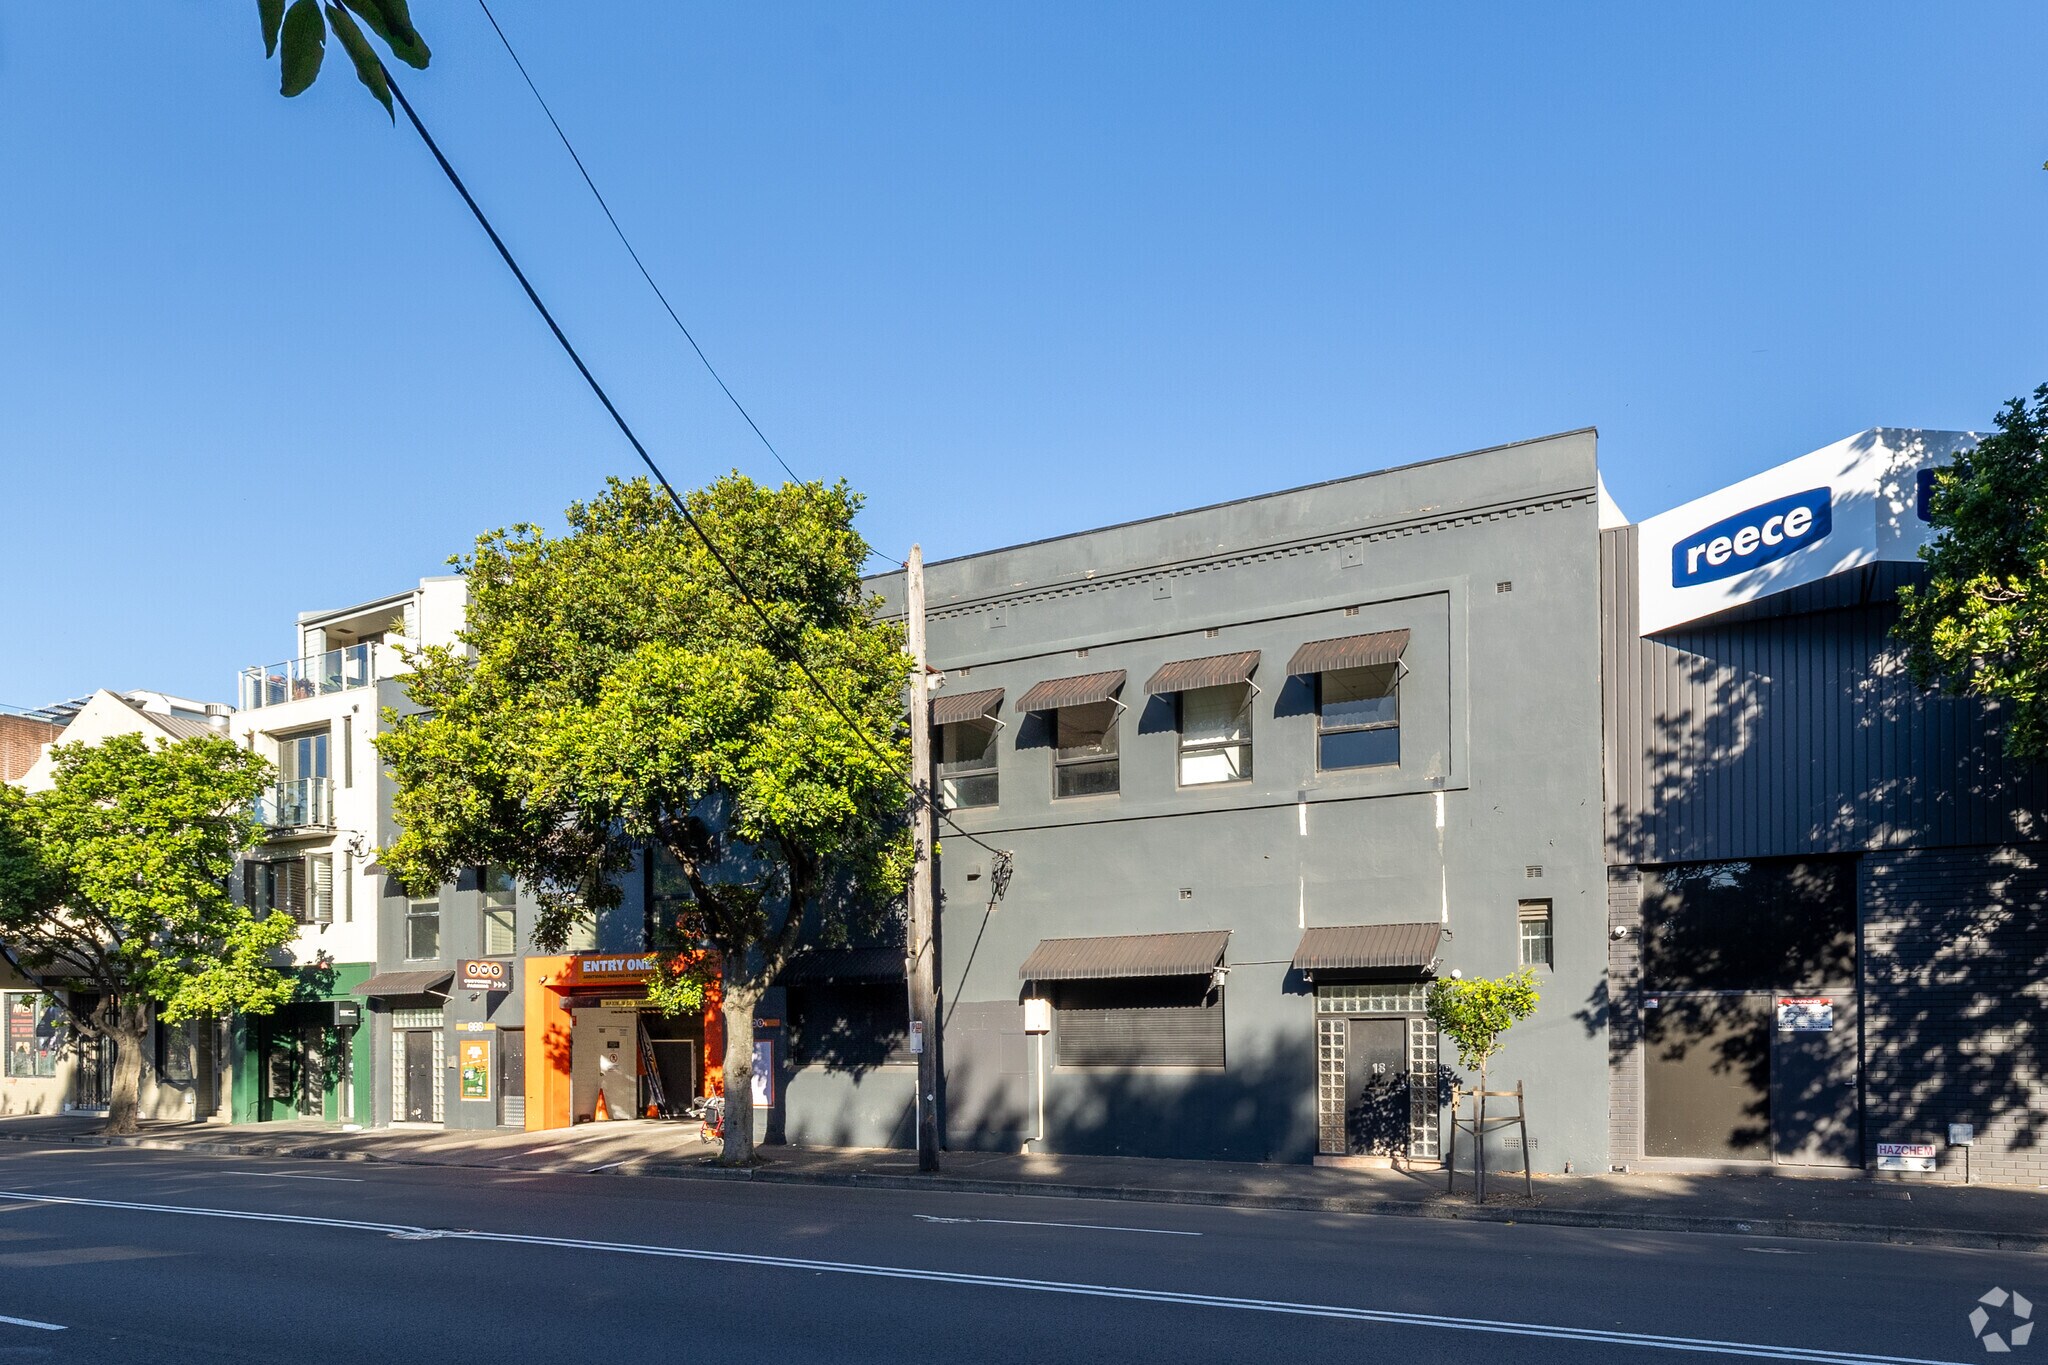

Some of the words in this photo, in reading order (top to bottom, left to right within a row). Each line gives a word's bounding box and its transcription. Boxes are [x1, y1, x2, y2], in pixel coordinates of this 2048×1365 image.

[1687, 507, 1813, 575] reece
[467, 963, 501, 977] BWS
[583, 960, 624, 972] ENTRY
[1372, 1062, 1386, 1074] 18
[1879, 1145, 1933, 1156] HAZCHEM
